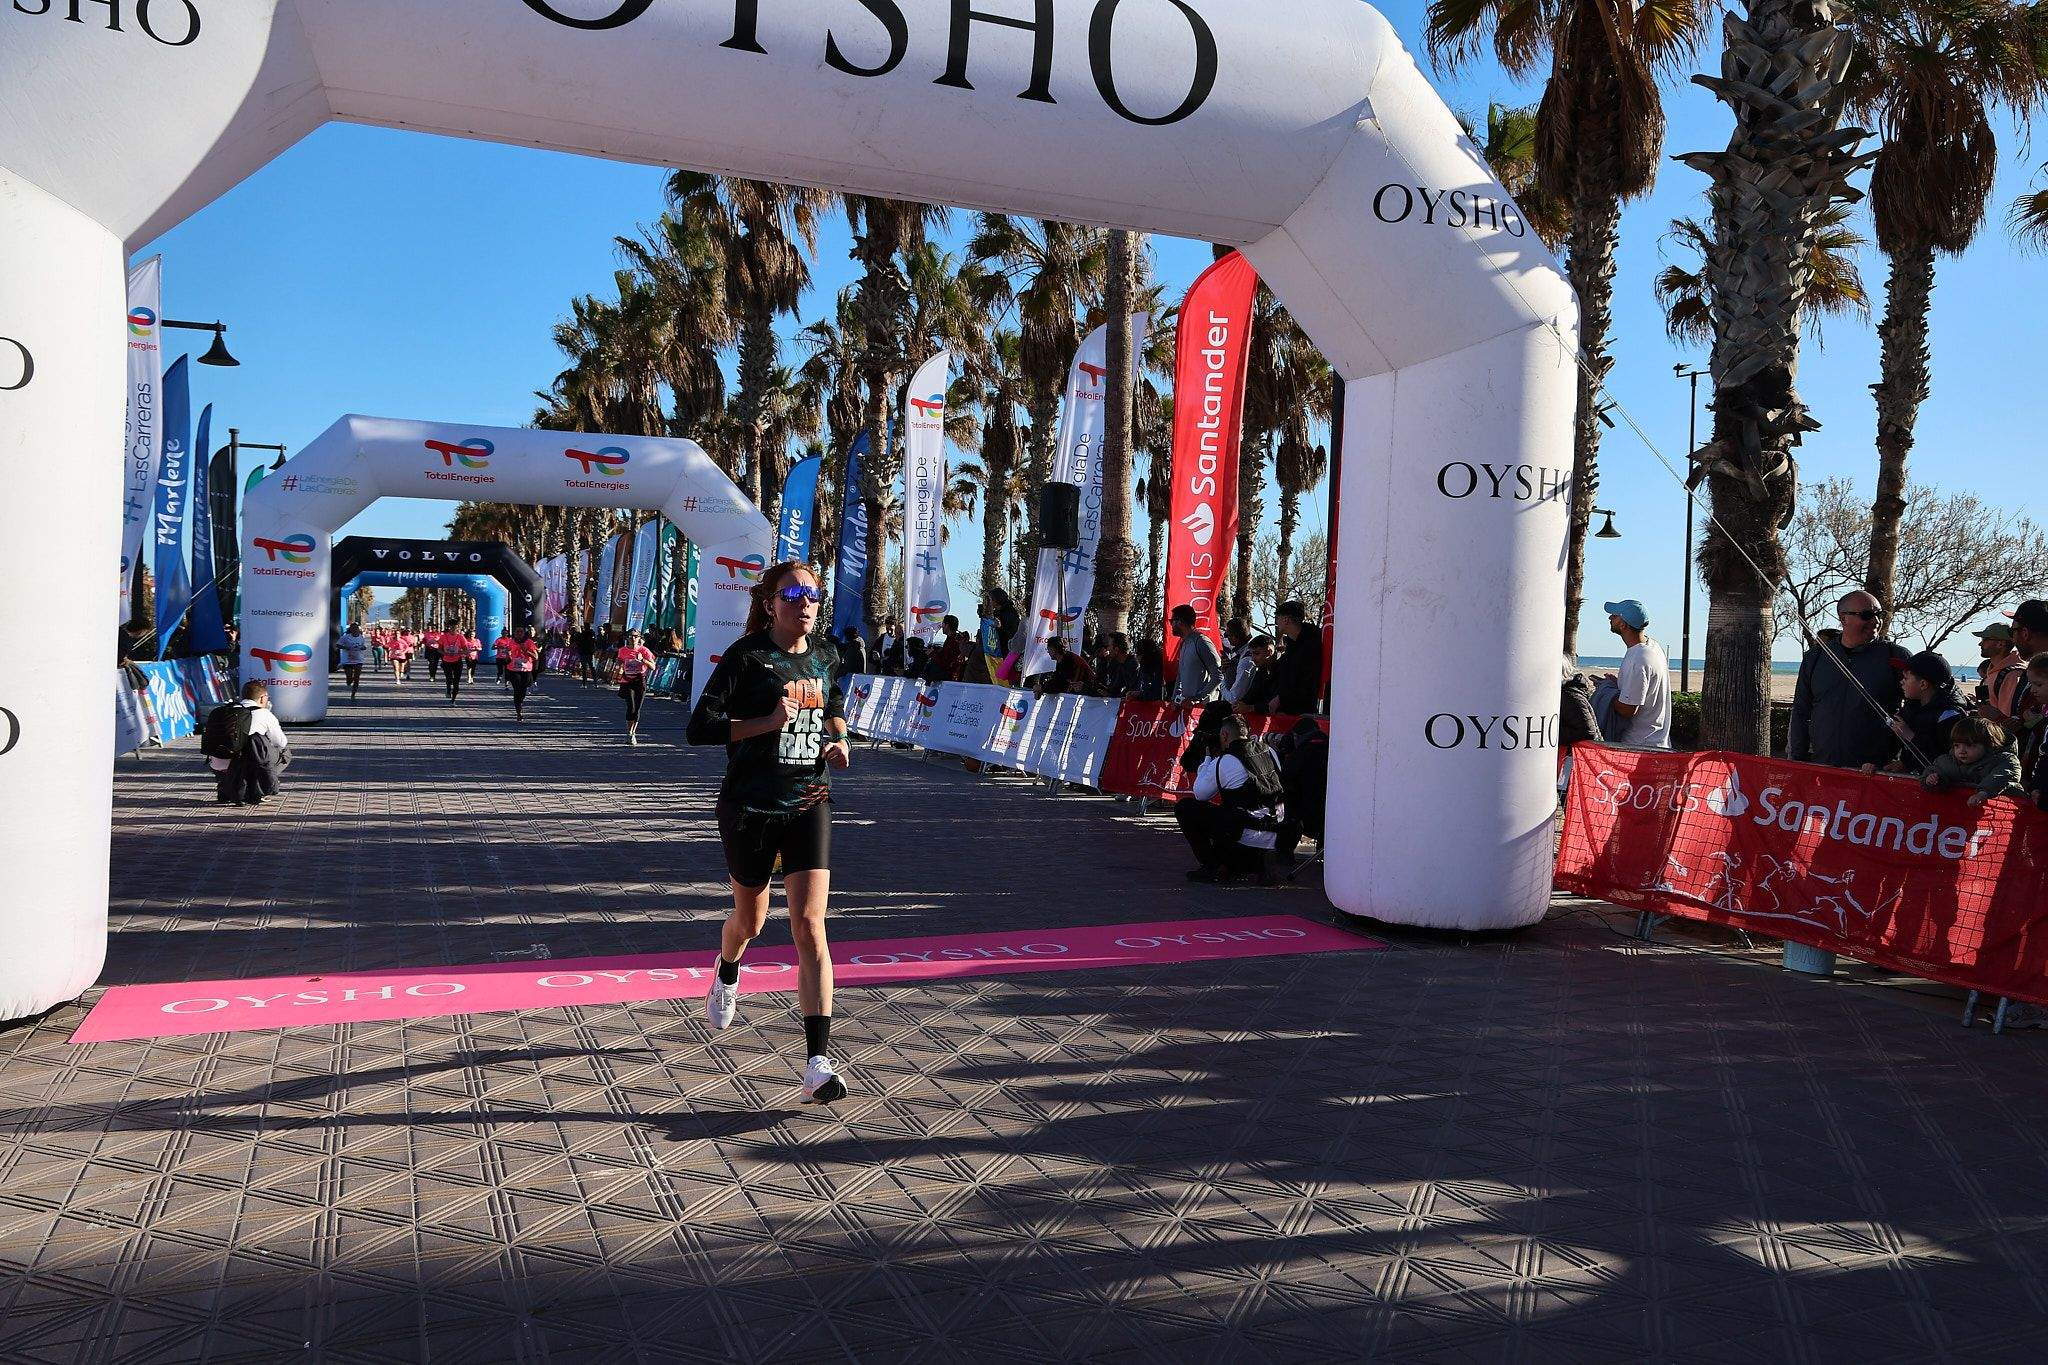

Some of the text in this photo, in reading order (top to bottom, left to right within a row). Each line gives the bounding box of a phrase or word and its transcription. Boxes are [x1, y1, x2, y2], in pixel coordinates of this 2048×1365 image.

[519, 0, 1219, 126] SHO
[1372, 183, 1526, 238] OYSHO
[127, 340, 158, 352] nergies
[1075, 389, 1106, 401] TotalEn
[1191, 310, 1230, 497] Santander
[132, 382, 151, 493] LasCarreras
[424, 471, 496, 484] TotalEnergies
[564, 479, 631, 491] TotalEnergies
[1437, 461, 1574, 505] OYSHO
[158, 437, 187, 546] Marlene
[778, 508, 805, 566] arlene
[842, 497, 868, 577] Marle
[373, 549, 482, 563] VOLVO
[252, 567, 316, 578] TotalEnergies
[714, 582, 751, 592] TotalEne
[1185, 552, 1213, 632] ports
[251, 609, 314, 618] totalenergies.es
[711, 619, 747, 629] totalenerg
[1126, 713, 1170, 740] Sports
[1424, 713, 1559, 751] OYSHO
[779, 732, 821, 759] RAS
[1592, 769, 1994, 859] Sports Santander
[1113, 927, 1307, 949] OYSHO
[849, 943, 1069, 966] OYSHO
[160, 982, 466, 1014] OYSHO
